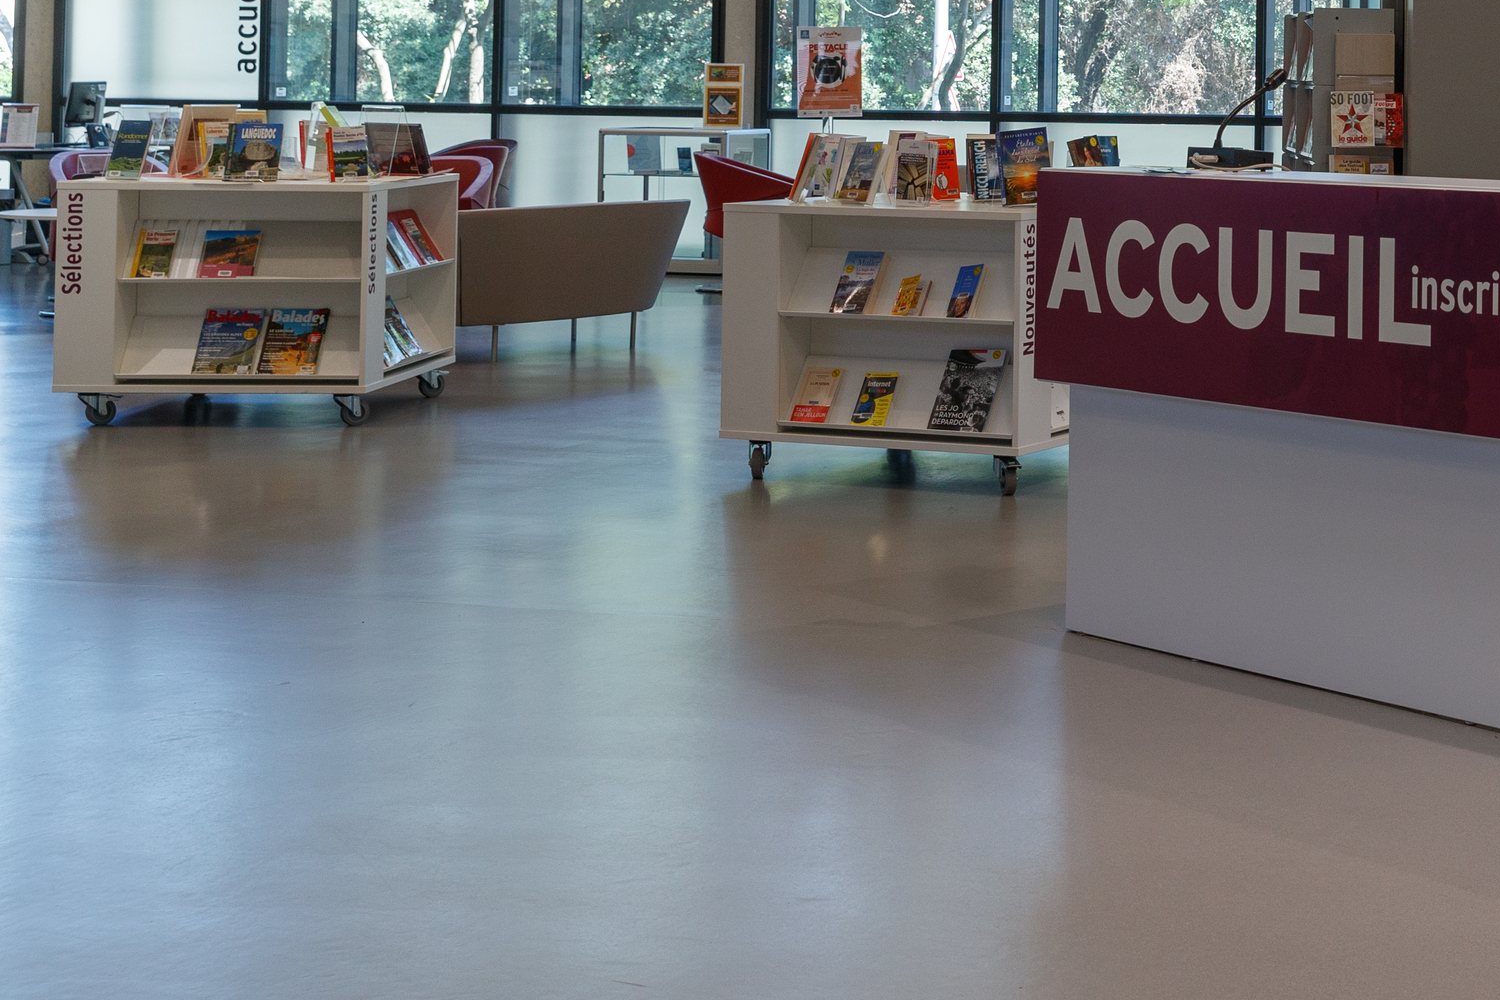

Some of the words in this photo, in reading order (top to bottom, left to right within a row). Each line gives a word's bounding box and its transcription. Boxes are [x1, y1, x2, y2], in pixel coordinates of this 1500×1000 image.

[1330, 93, 1344, 105] SO
[1347, 93, 1374, 105] FOOT
[241, 127, 277, 140] LANGUEDOC
[1338, 135, 1345, 143] le
[1346, 135, 1368, 144] guide
[974, 140, 987, 174] FRENCH
[60, 192, 84, 294] Sélections
[368, 194, 378, 294] Sélections
[1022, 223, 1036, 356] Nouveautés
[1046, 216, 1432, 347] ACCUEIL
[206, 310, 260, 324] Balades
[272, 310, 326, 324] Balades
